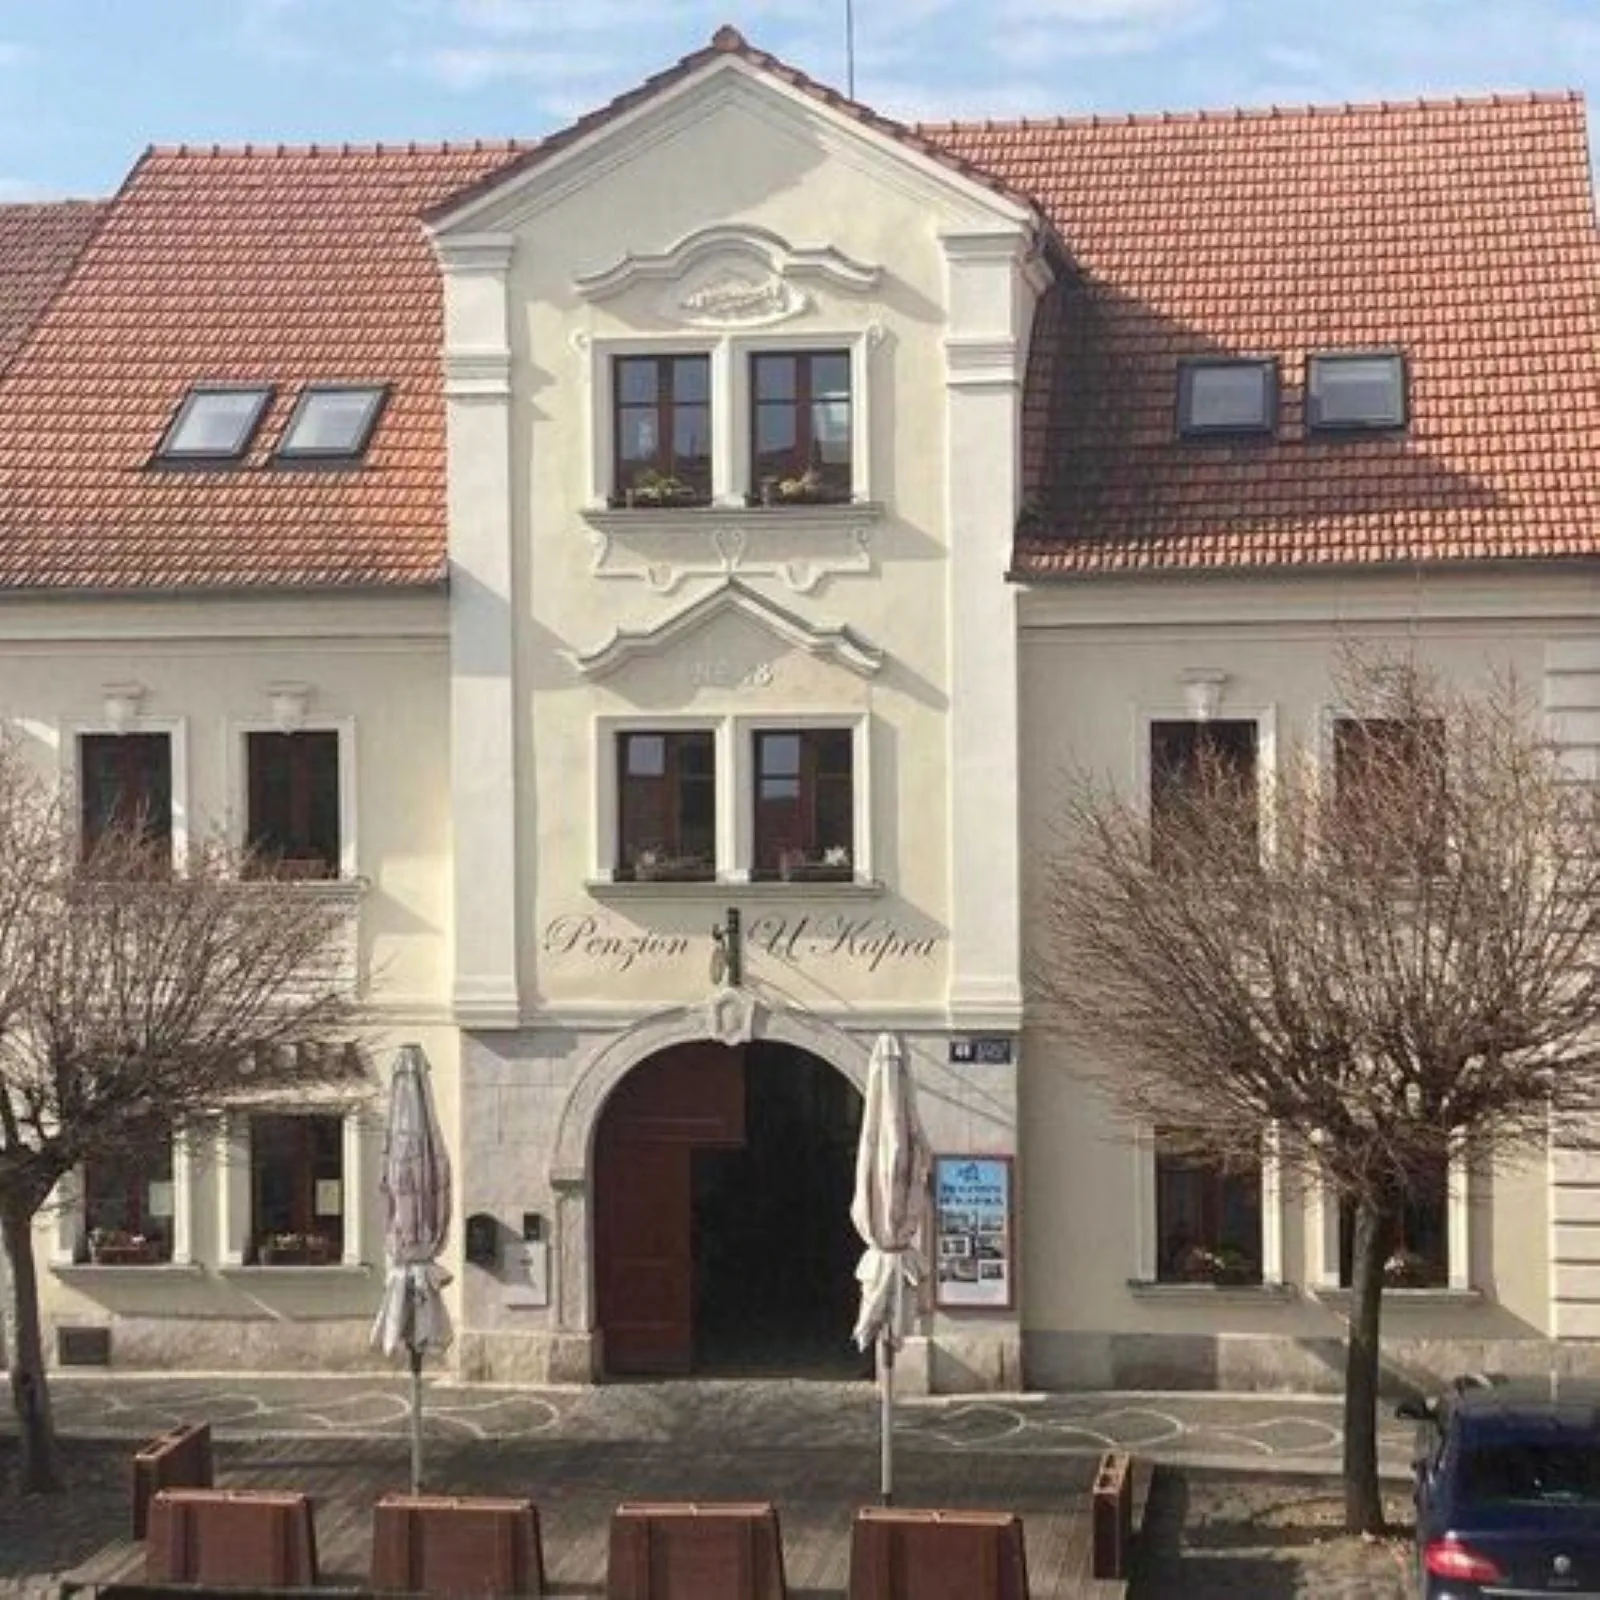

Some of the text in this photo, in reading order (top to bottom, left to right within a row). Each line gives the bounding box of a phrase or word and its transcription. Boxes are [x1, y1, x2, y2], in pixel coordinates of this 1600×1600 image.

[543, 912, 936, 973] Penzion U Kapra
